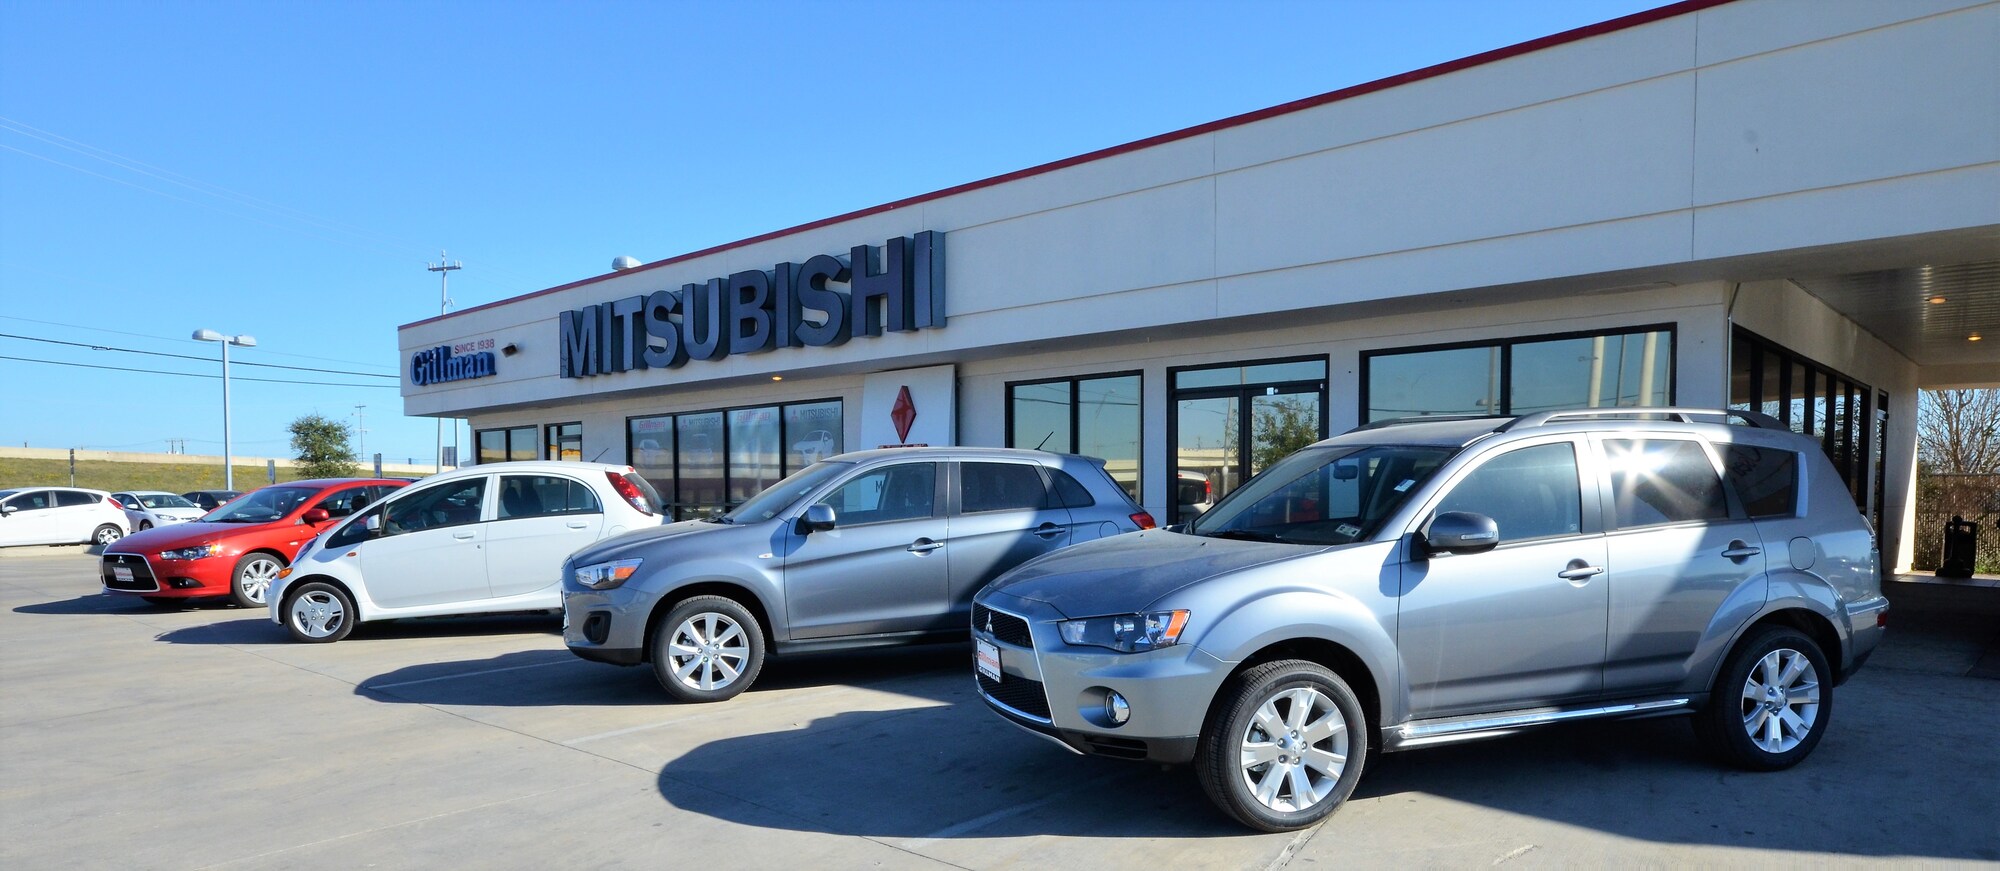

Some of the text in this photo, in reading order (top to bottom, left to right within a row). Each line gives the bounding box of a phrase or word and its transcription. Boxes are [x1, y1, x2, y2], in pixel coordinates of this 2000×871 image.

[560, 230, 946, 379] MITSUBISHI
[454, 338, 495, 354] SINCE 1938
[410, 345, 497, 386] Gillman
[800, 407, 839, 420] MITSUBISHI
[638, 420, 666, 430] Gillman
